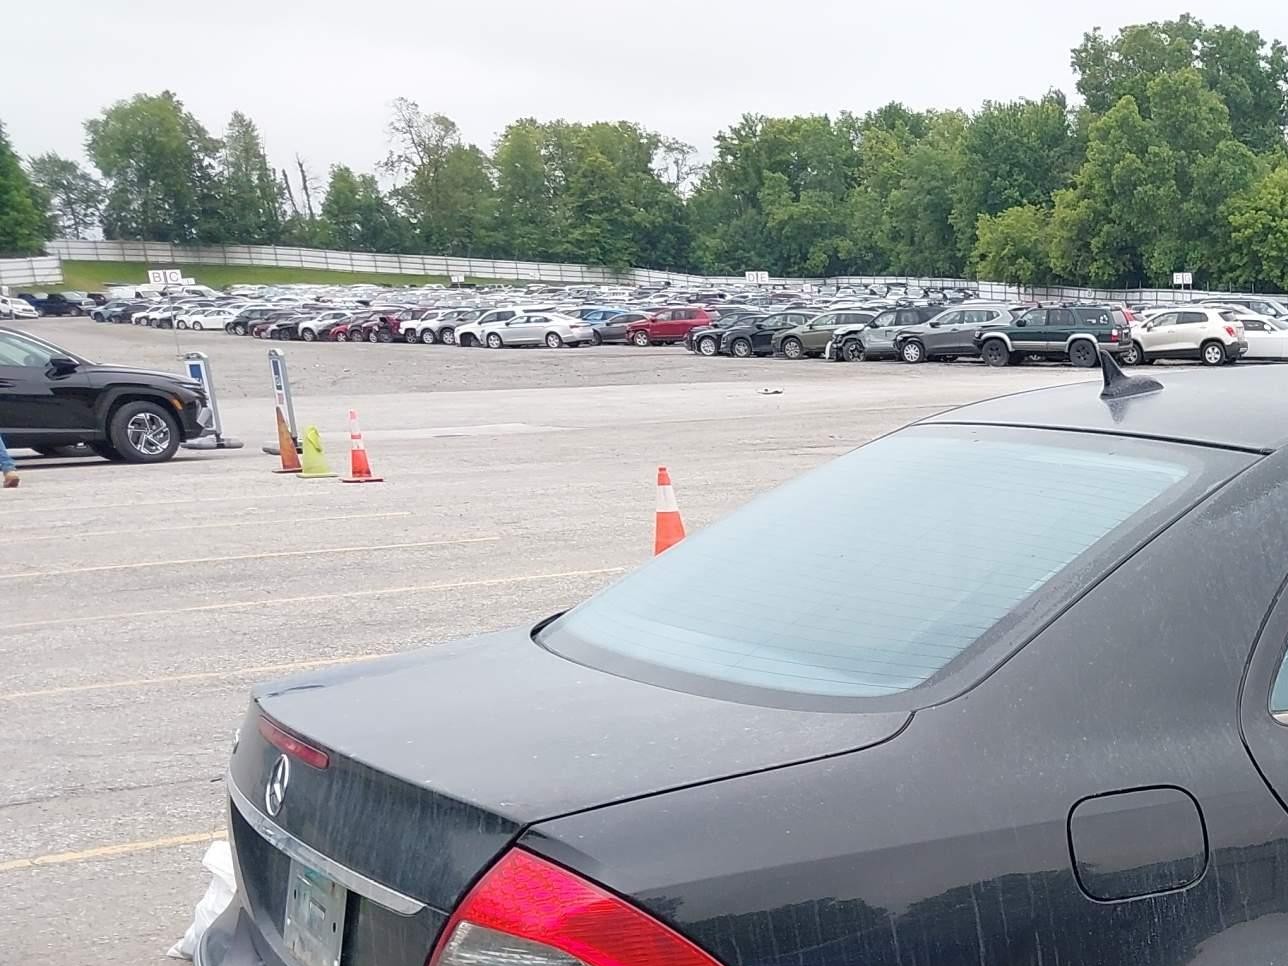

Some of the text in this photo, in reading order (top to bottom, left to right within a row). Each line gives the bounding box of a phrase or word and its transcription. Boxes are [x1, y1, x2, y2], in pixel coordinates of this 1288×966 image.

[152, 272, 161, 282] B
[169, 271, 178, 282] C
[760, 272, 767, 282] E
